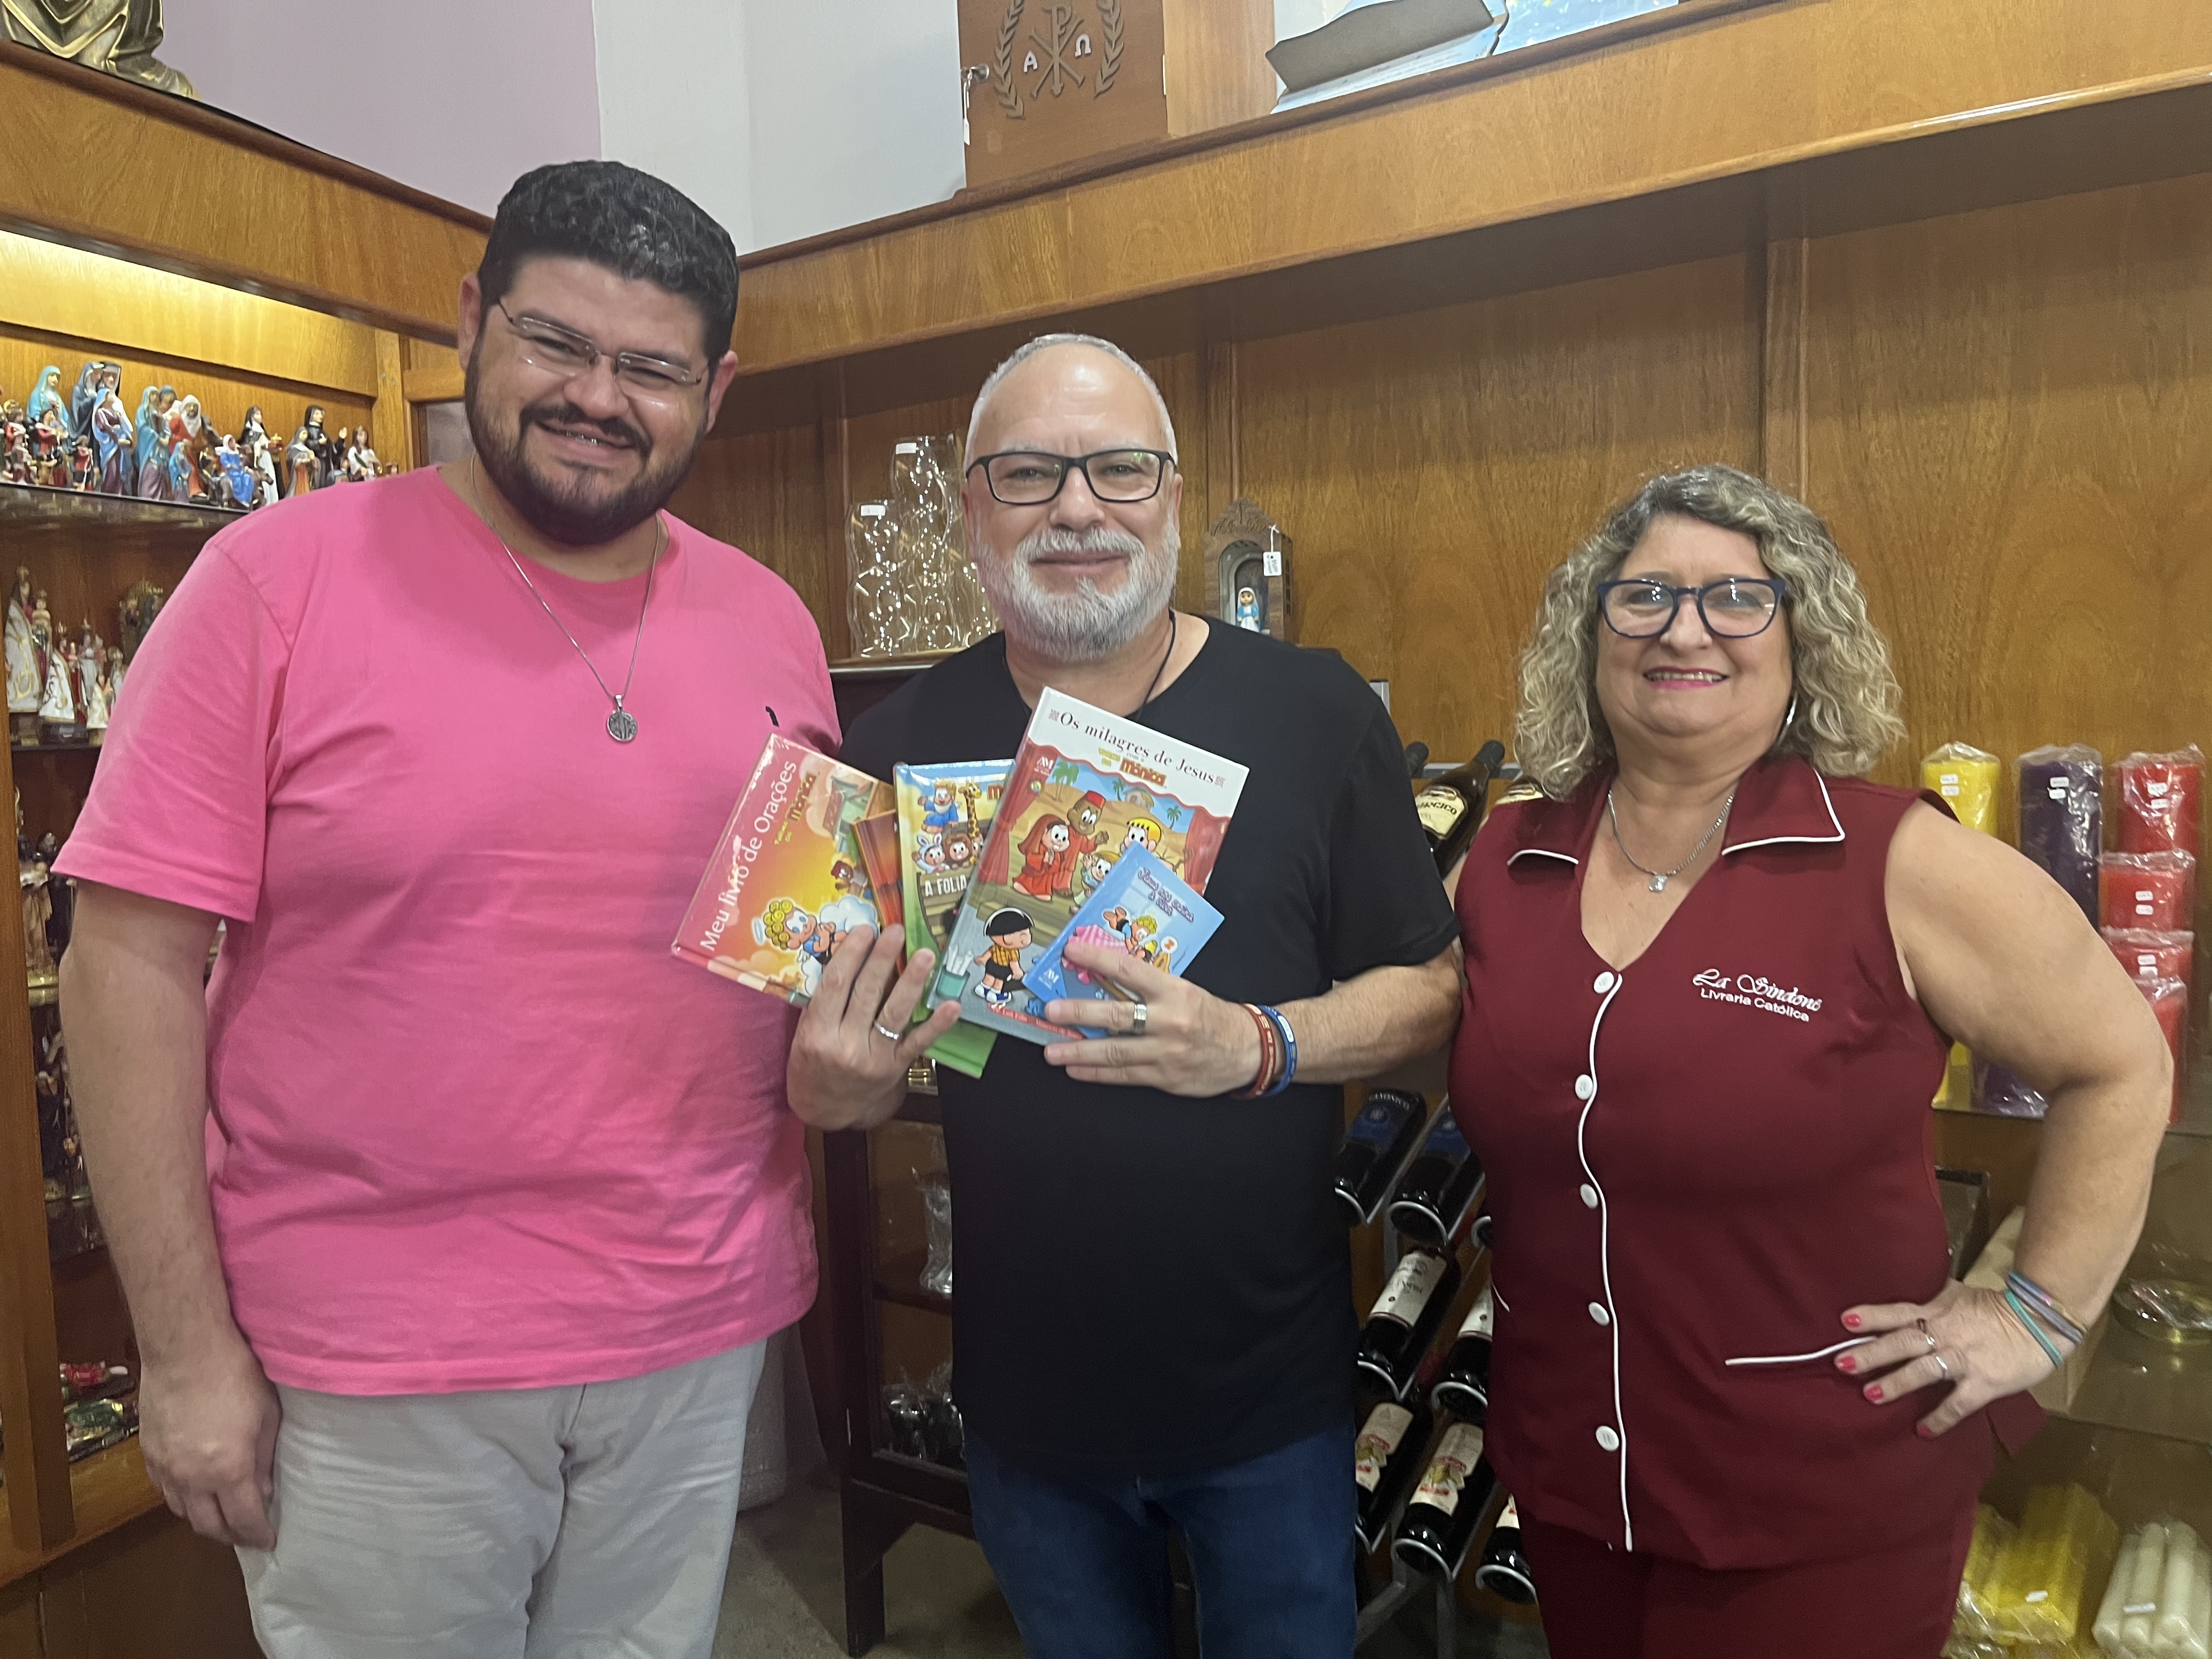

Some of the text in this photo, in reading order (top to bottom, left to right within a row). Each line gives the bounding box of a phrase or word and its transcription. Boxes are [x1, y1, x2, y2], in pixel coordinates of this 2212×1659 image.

[1060, 712, 1215, 783] Os milagres de Jesus
[700, 760, 797, 951] Meu livro de Orações
[925, 874, 968, 897] A FOLIA
[1692, 968, 1731, 989] La
[1701, 988, 1752, 1006] Livraria
